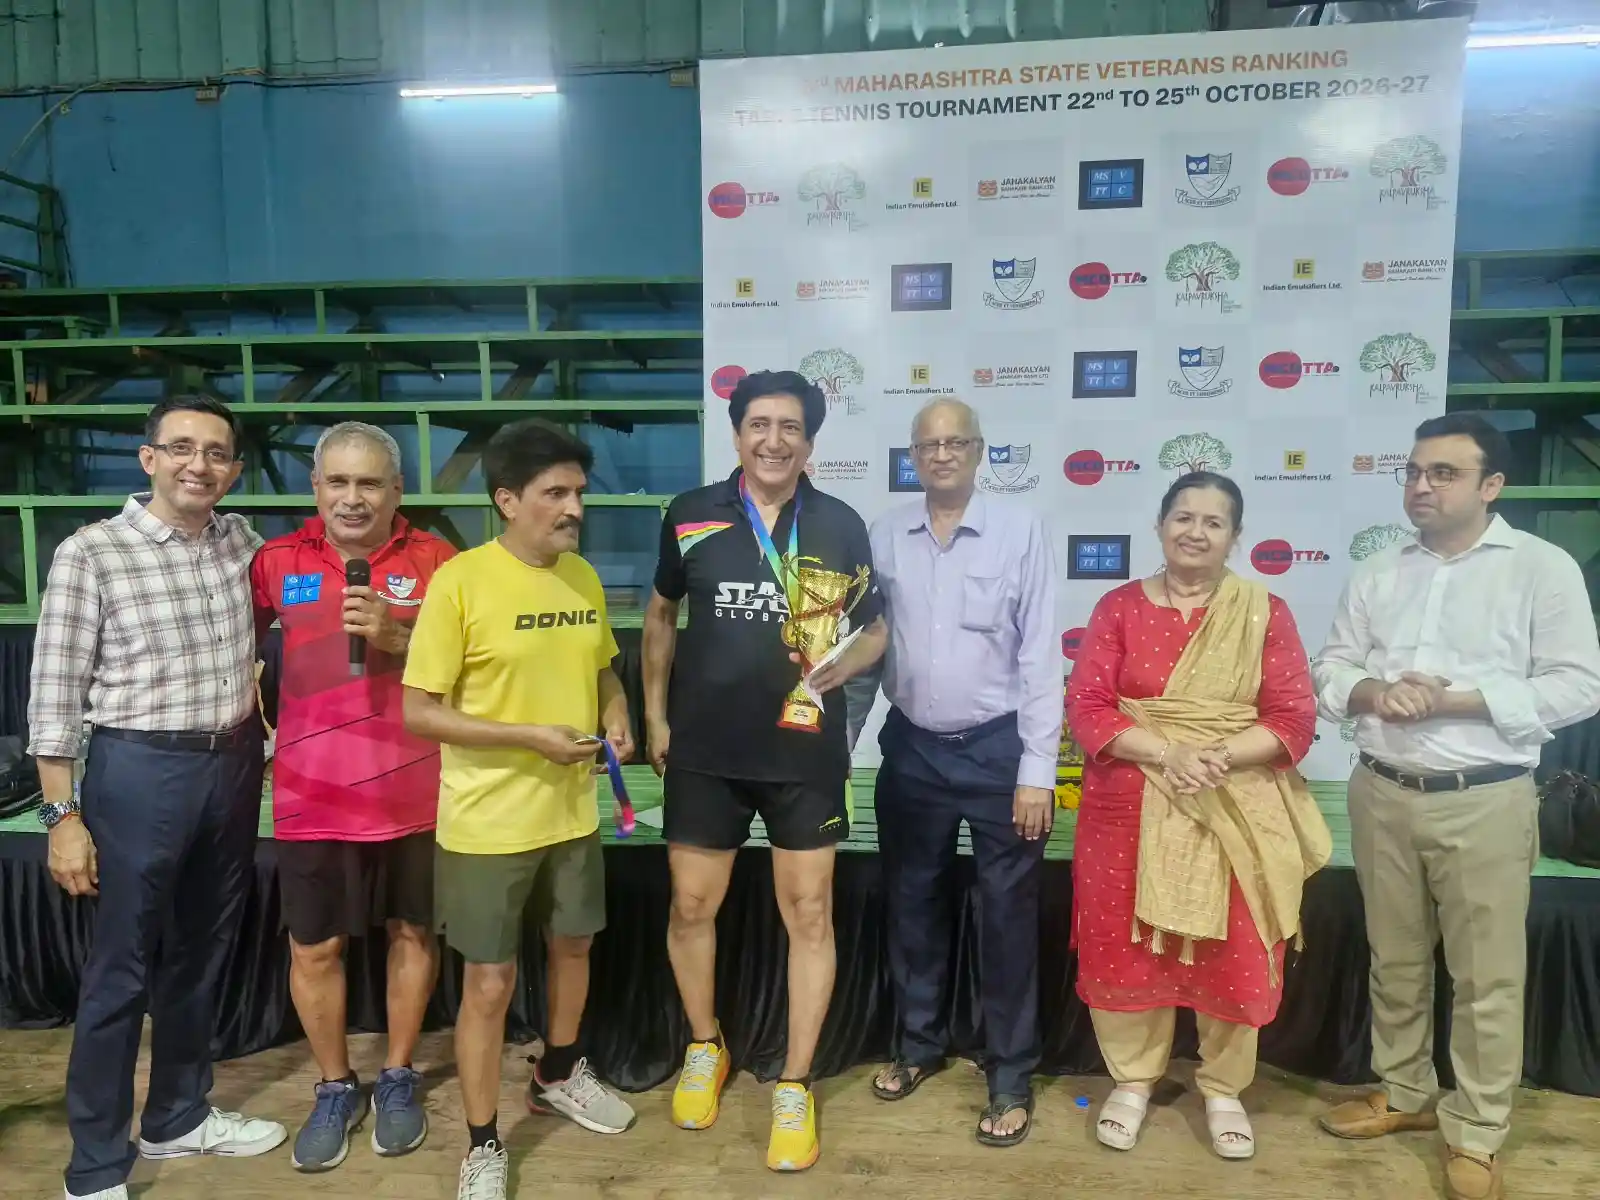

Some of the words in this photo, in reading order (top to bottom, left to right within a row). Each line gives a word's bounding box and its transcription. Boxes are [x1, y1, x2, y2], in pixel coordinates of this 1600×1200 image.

[834, 67, 1013, 94] MAHARASHTRA
[1019, 63, 1090, 84] STATE
[1096, 56, 1225, 80] VETERANS
[1231, 50, 1348, 73] RANKING
[896, 94, 1062, 119] TOURNAMENT
[1066, 89, 1114, 110] 22nd
[1119, 89, 1149, 108] TO
[1155, 84, 1199, 106] 25th
[1205, 80, 1321, 103] OCTOBER
[1327, 75, 1430, 98] 2026-27
[1093, 172, 1109, 181] MS
[1119, 170, 1127, 179] V
[1000, 176, 1056, 186] JANAKALYAN
[916, 182, 929, 193] IE
[1095, 187, 1108, 195] TT
[1118, 186, 1126, 195] C
[1388, 259, 1447, 268] JANAKALYAN
[1297, 263, 1312, 275] IE
[905, 276, 920, 285] MS
[928, 275, 936, 283] V
[738, 282, 751, 293] IE
[1263, 283, 1286, 291] Indian
[1287, 282, 1327, 290] Emulsifiers
[906, 290, 918, 298] TT
[928, 289, 936, 297] C
[997, 366, 1050, 374] JANAKALYAN
[1088, 362, 1103, 370] MS
[1113, 361, 1121, 370] V
[913, 368, 926, 380] IE
[1088, 377, 1102, 386] TT
[1111, 377, 1120, 385] C
[1288, 454, 1302, 466] IE
[1378, 454, 1408, 462] JANAK
[1278, 474, 1318, 482] Emulsifiers
[1082, 545, 1097, 553] MS
[1107, 544, 1115, 553] V
[1082, 559, 1097, 567] TT
[1106, 559, 1114, 567] C
[514, 609, 597, 631] DONIC
[715, 608, 786, 624] GLOBA
